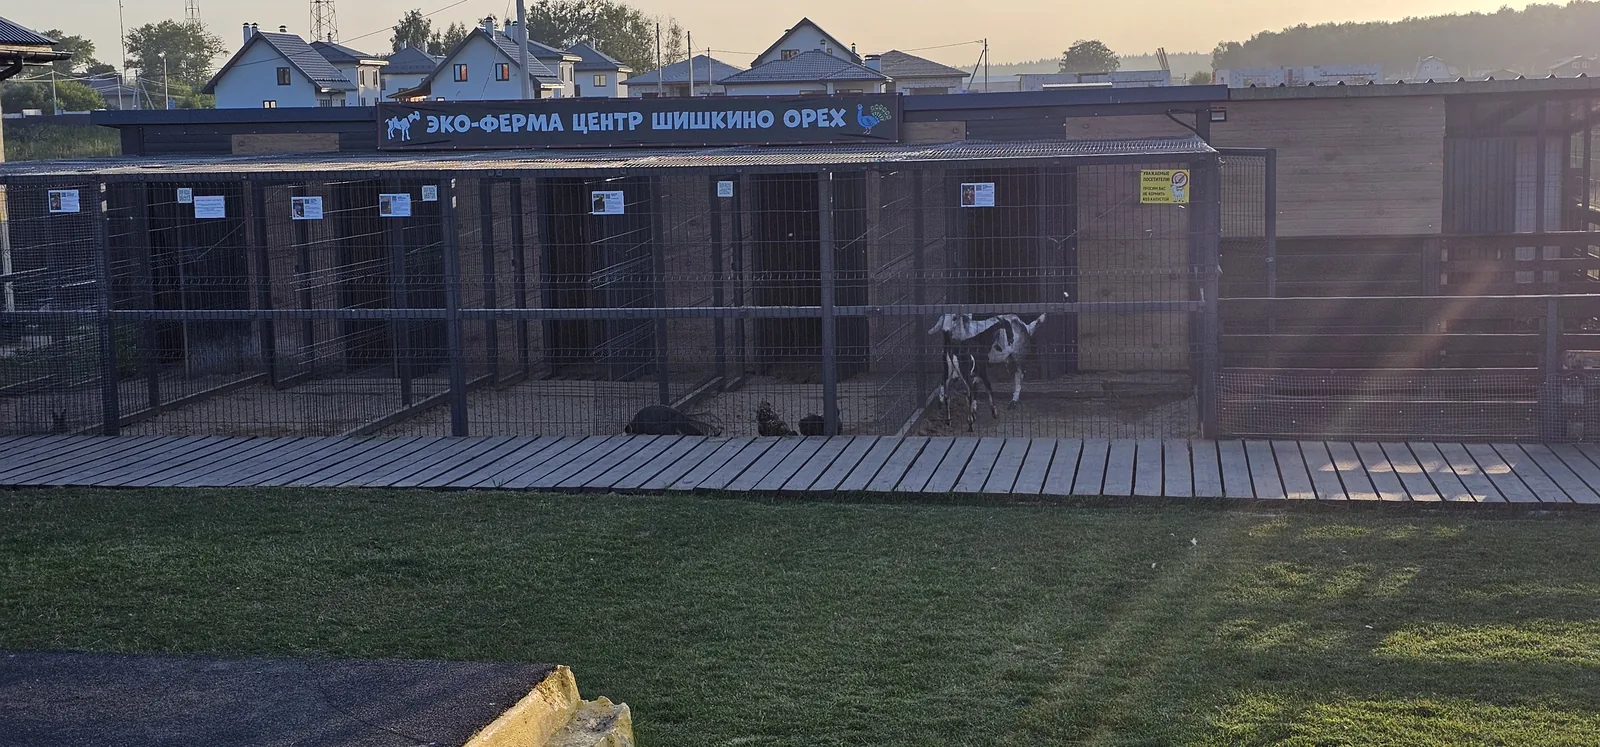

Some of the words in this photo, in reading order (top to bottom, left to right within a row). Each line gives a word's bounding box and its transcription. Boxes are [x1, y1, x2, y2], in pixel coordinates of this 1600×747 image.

[426, 113, 564, 134] ЭКО-ФЕРМА
[573, 112, 643, 134] ЦЕНТР
[652, 109, 775, 130] ШИШКИНО
[783, 107, 847, 128] ОРЕХ
